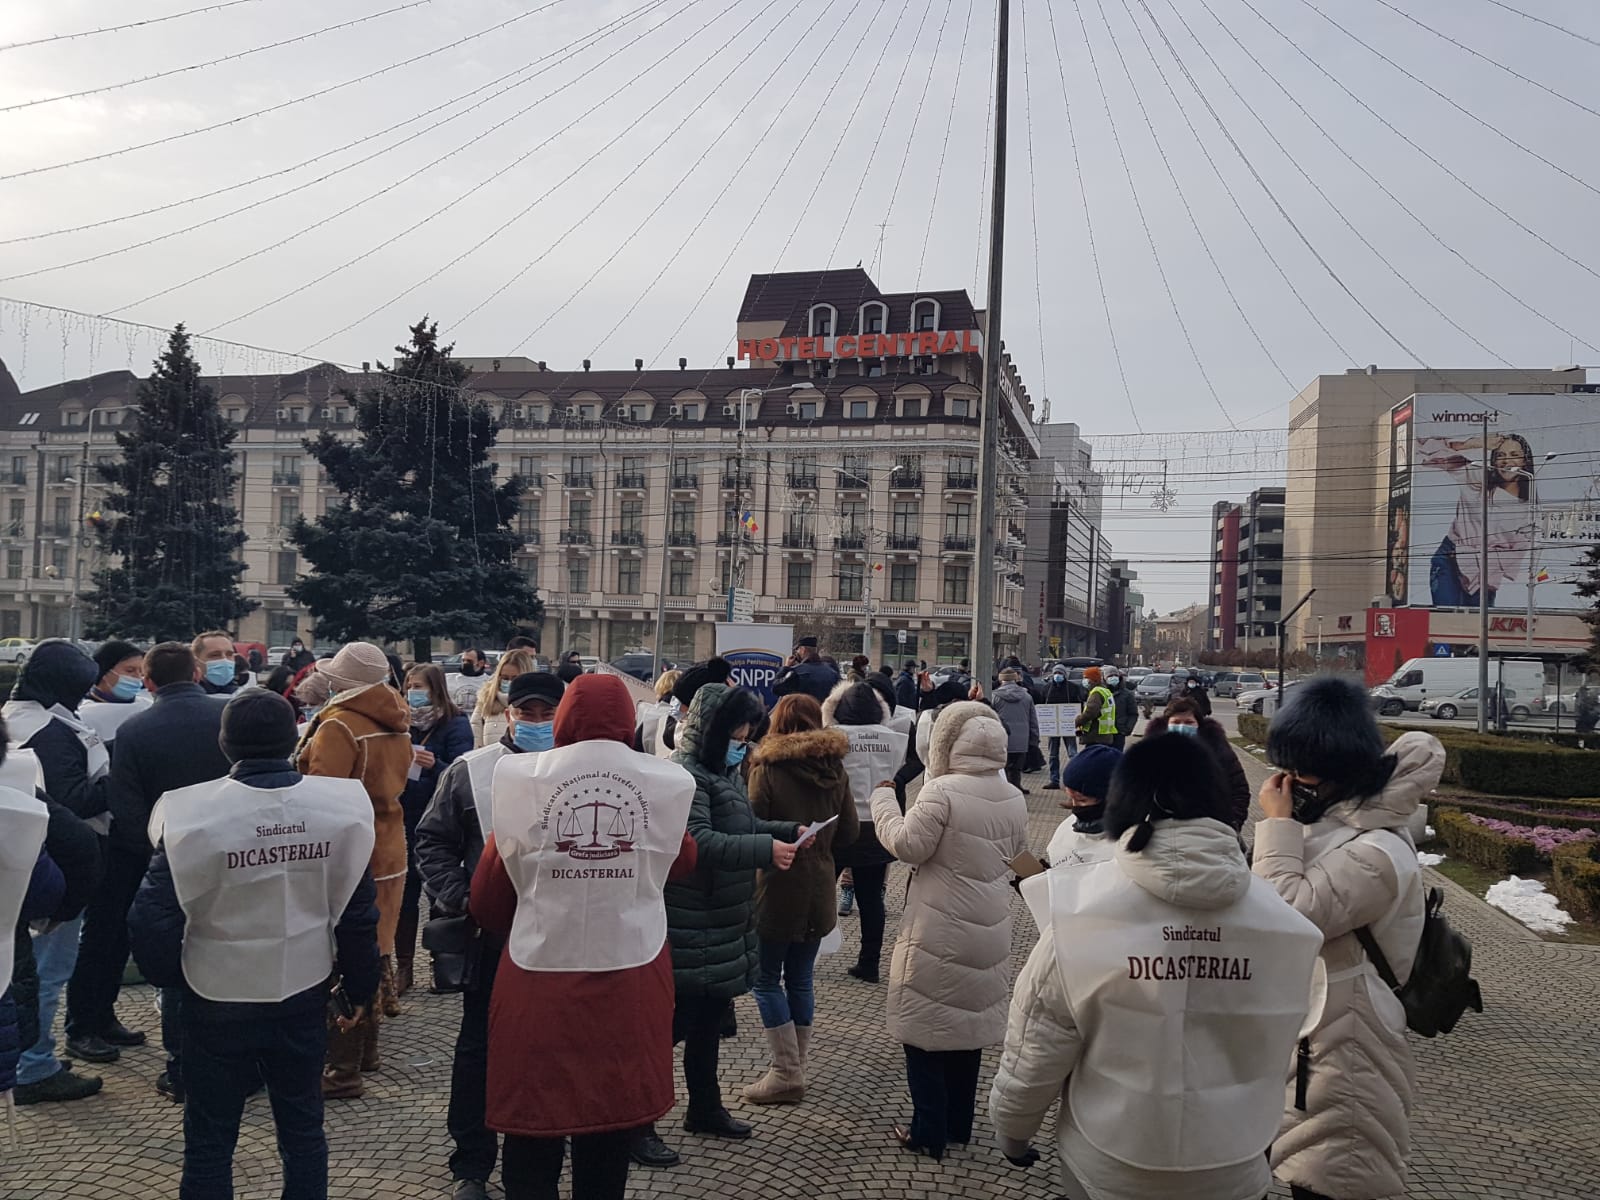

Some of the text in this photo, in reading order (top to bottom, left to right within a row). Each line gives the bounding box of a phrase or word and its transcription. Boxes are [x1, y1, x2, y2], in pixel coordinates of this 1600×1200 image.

[737, 330, 979, 360] HOTEL CENTRAL
[730, 667, 776, 688] SNPP
[541, 785, 563, 830] Sindicatul
[601, 771, 610, 779] al
[256, 821, 306, 838] Sindicatul
[552, 868, 634, 879] DICASTERIAL
[1162, 925, 1222, 942] Sindicatul
[1127, 955, 1252, 980] DICASTERIAL
